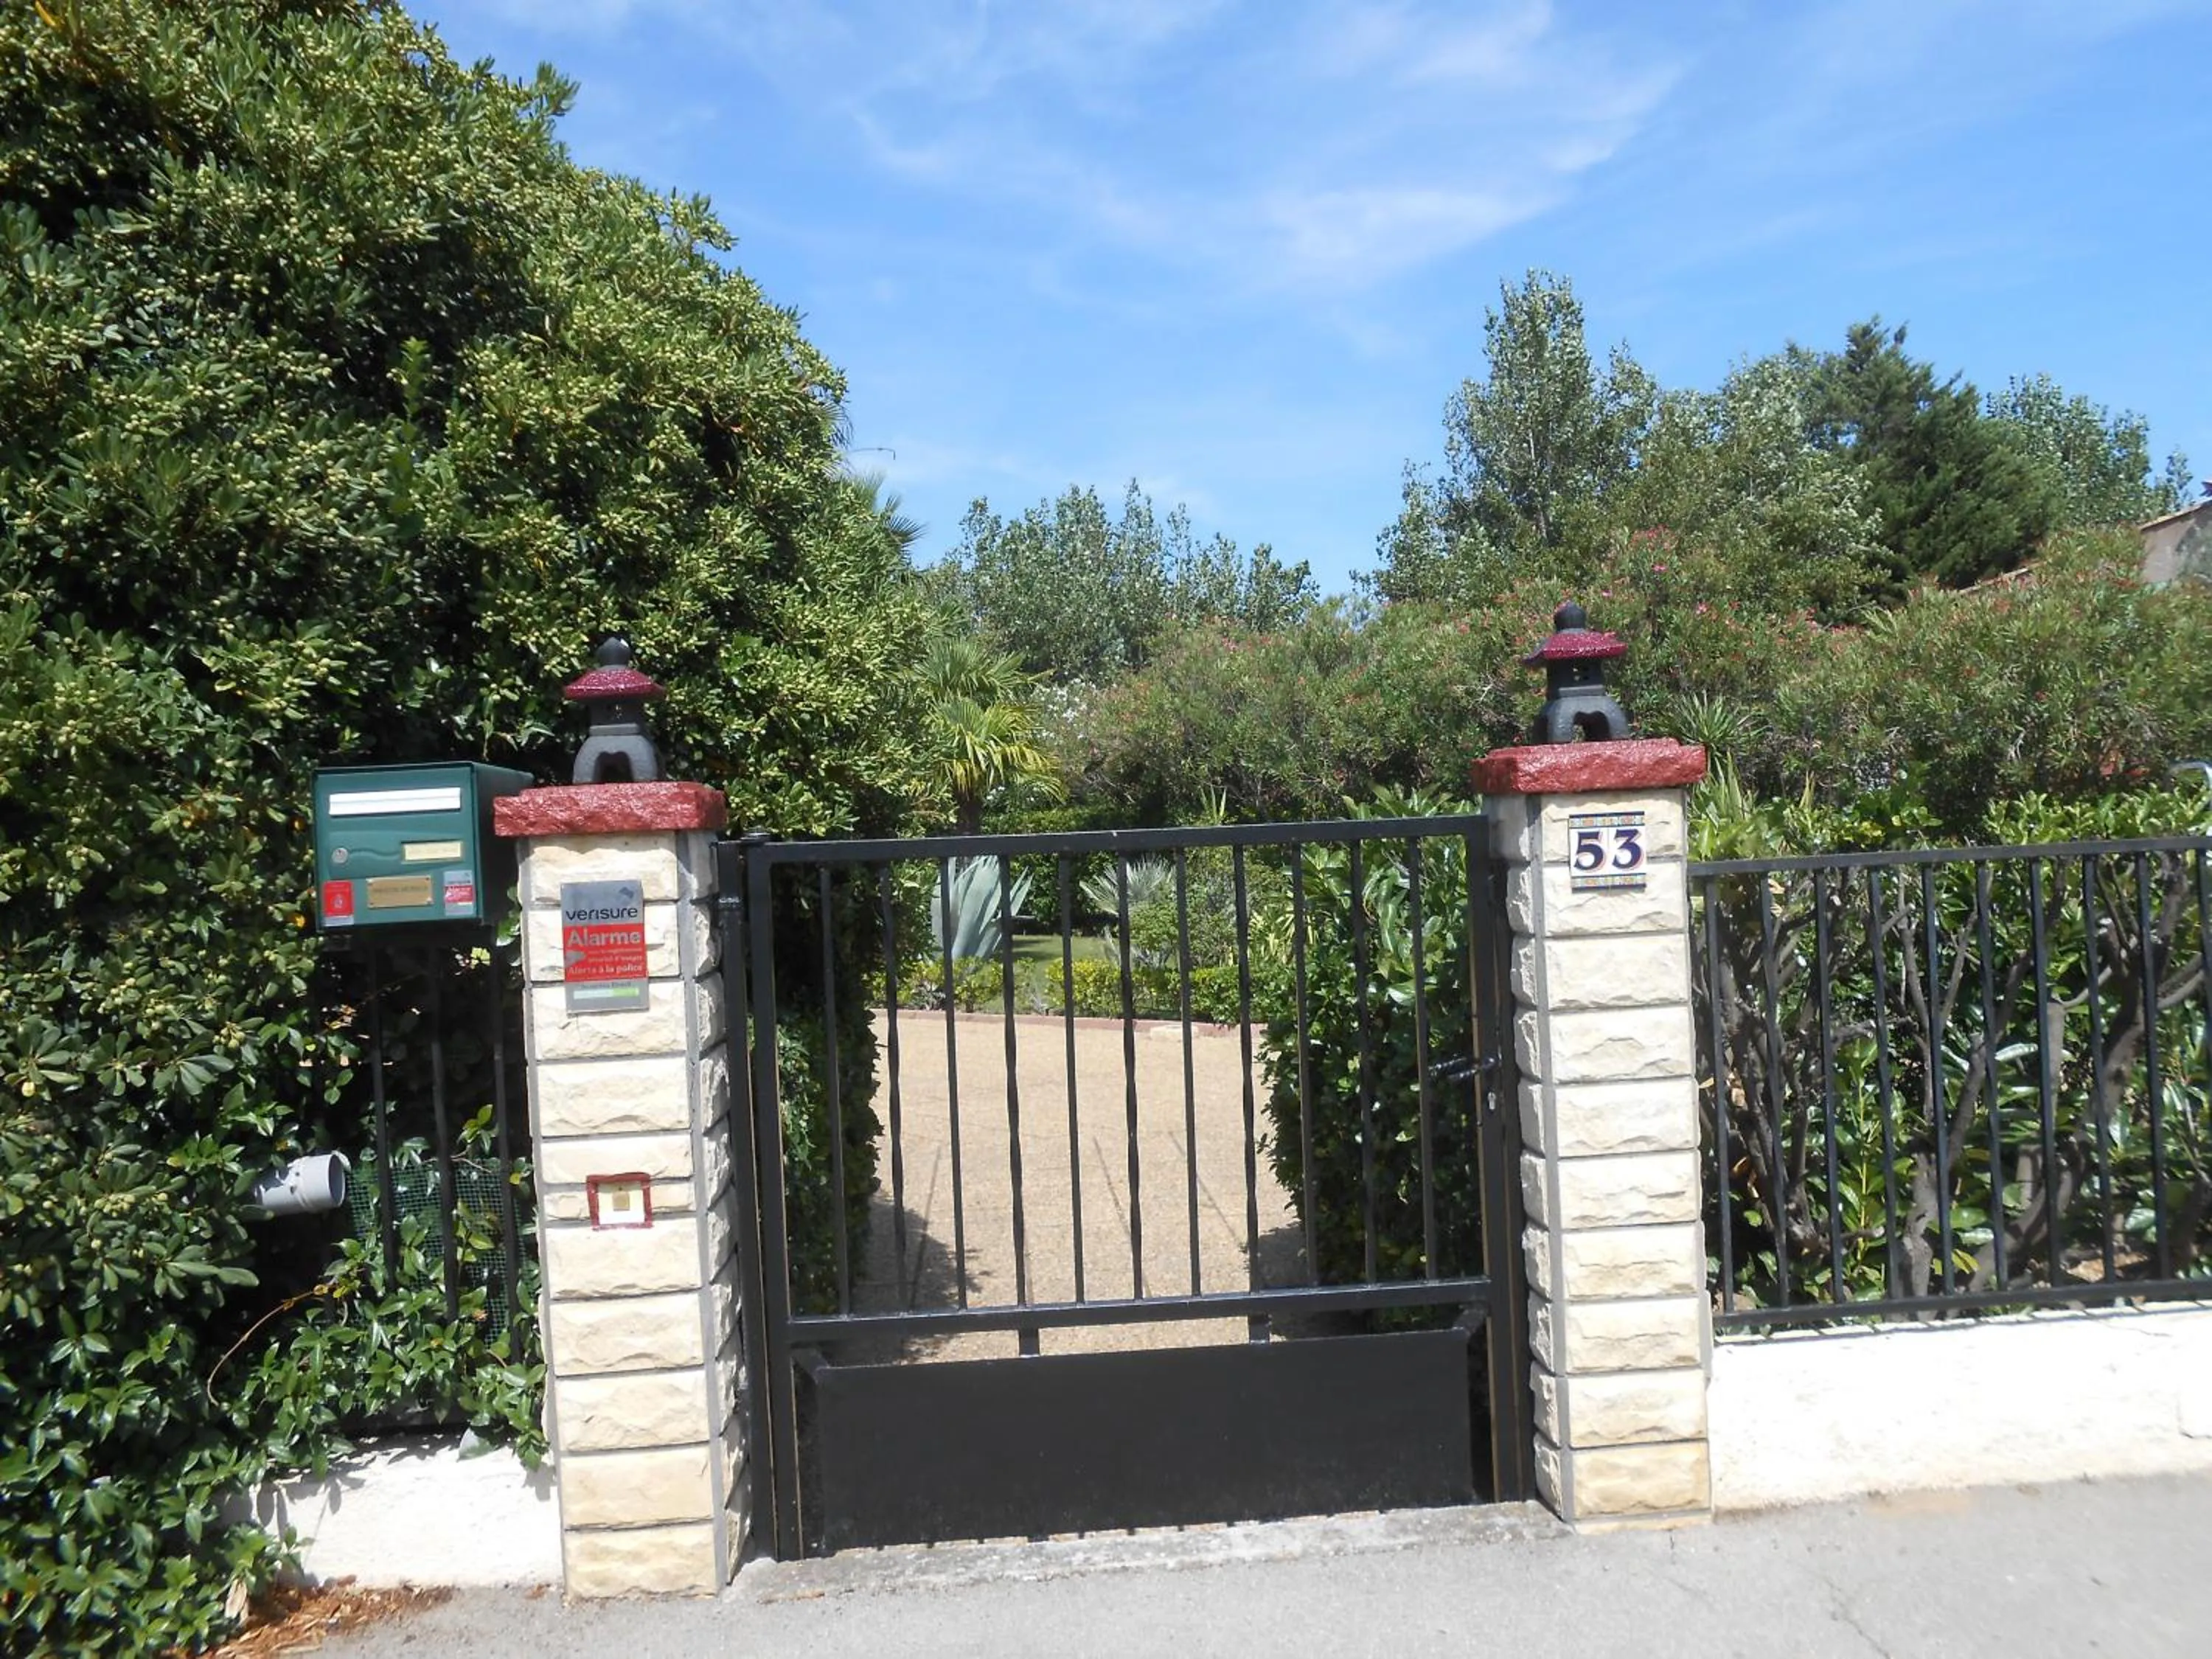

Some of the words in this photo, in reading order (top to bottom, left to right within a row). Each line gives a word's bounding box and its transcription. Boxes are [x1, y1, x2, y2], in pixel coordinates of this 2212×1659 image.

[1573, 829, 1642, 871] 53
[566, 907, 638, 921] verisure
[567, 927, 641, 947] Alarme
